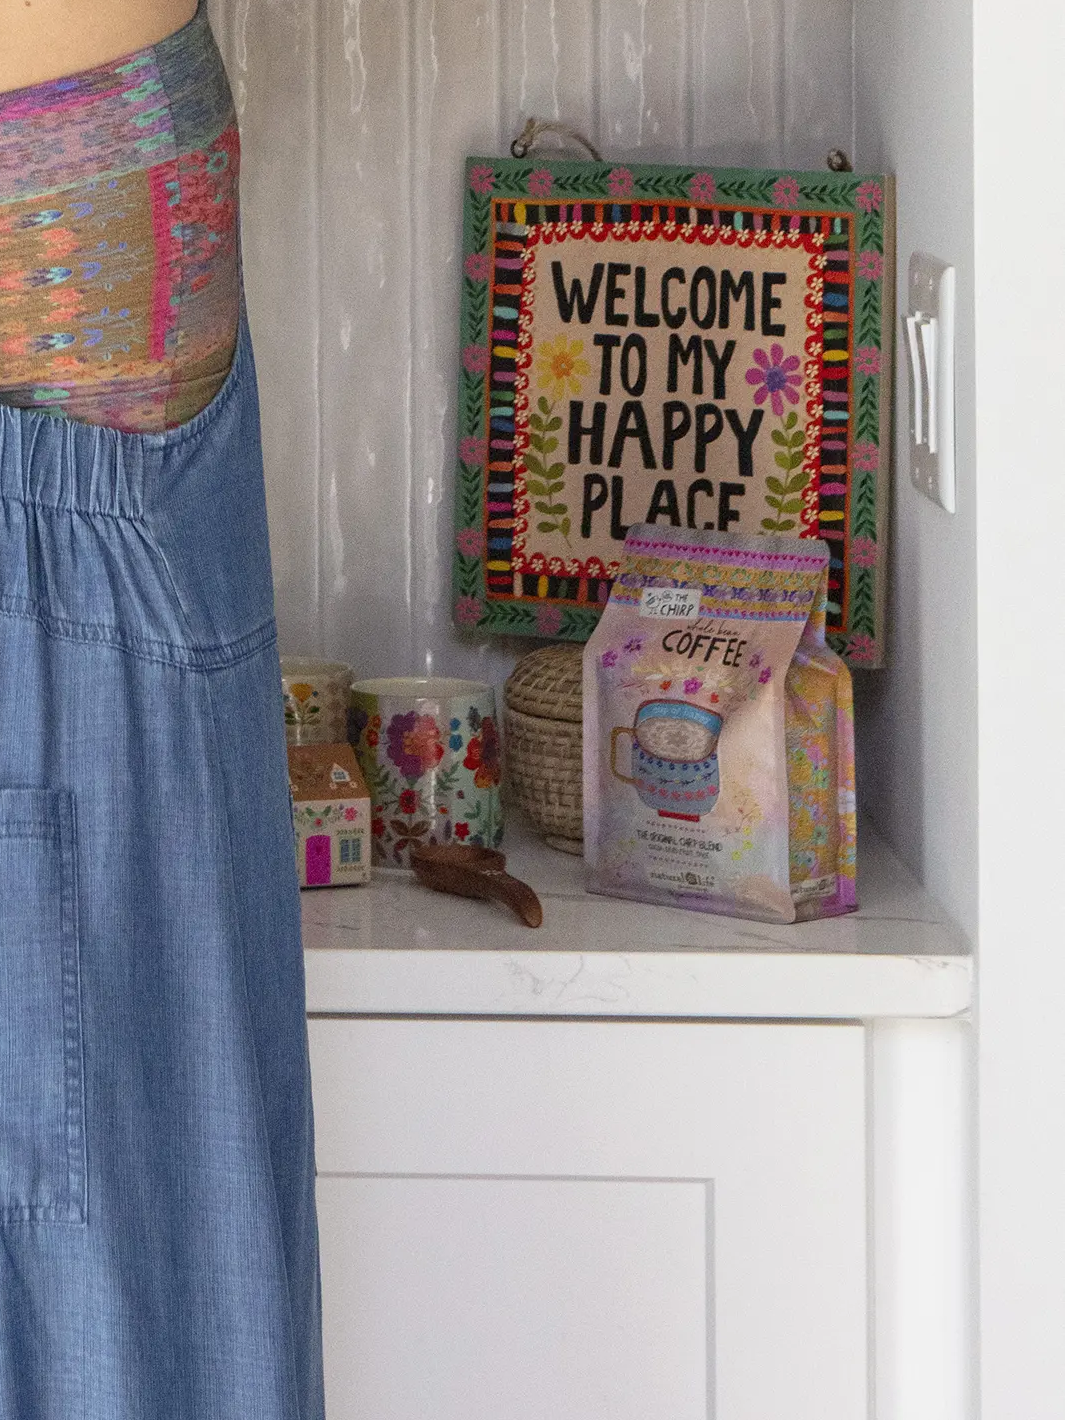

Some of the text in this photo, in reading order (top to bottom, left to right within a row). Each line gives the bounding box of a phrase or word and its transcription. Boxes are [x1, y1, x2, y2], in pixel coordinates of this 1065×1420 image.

[551, 261, 787, 337] WELCOME
[593, 332, 736, 400] TO MY
[567, 400, 764, 477] HAPPY
[582, 472, 746, 541] PLACE
[660, 603, 694, 617] CHIRP
[662, 629, 747, 668] COFFEE
